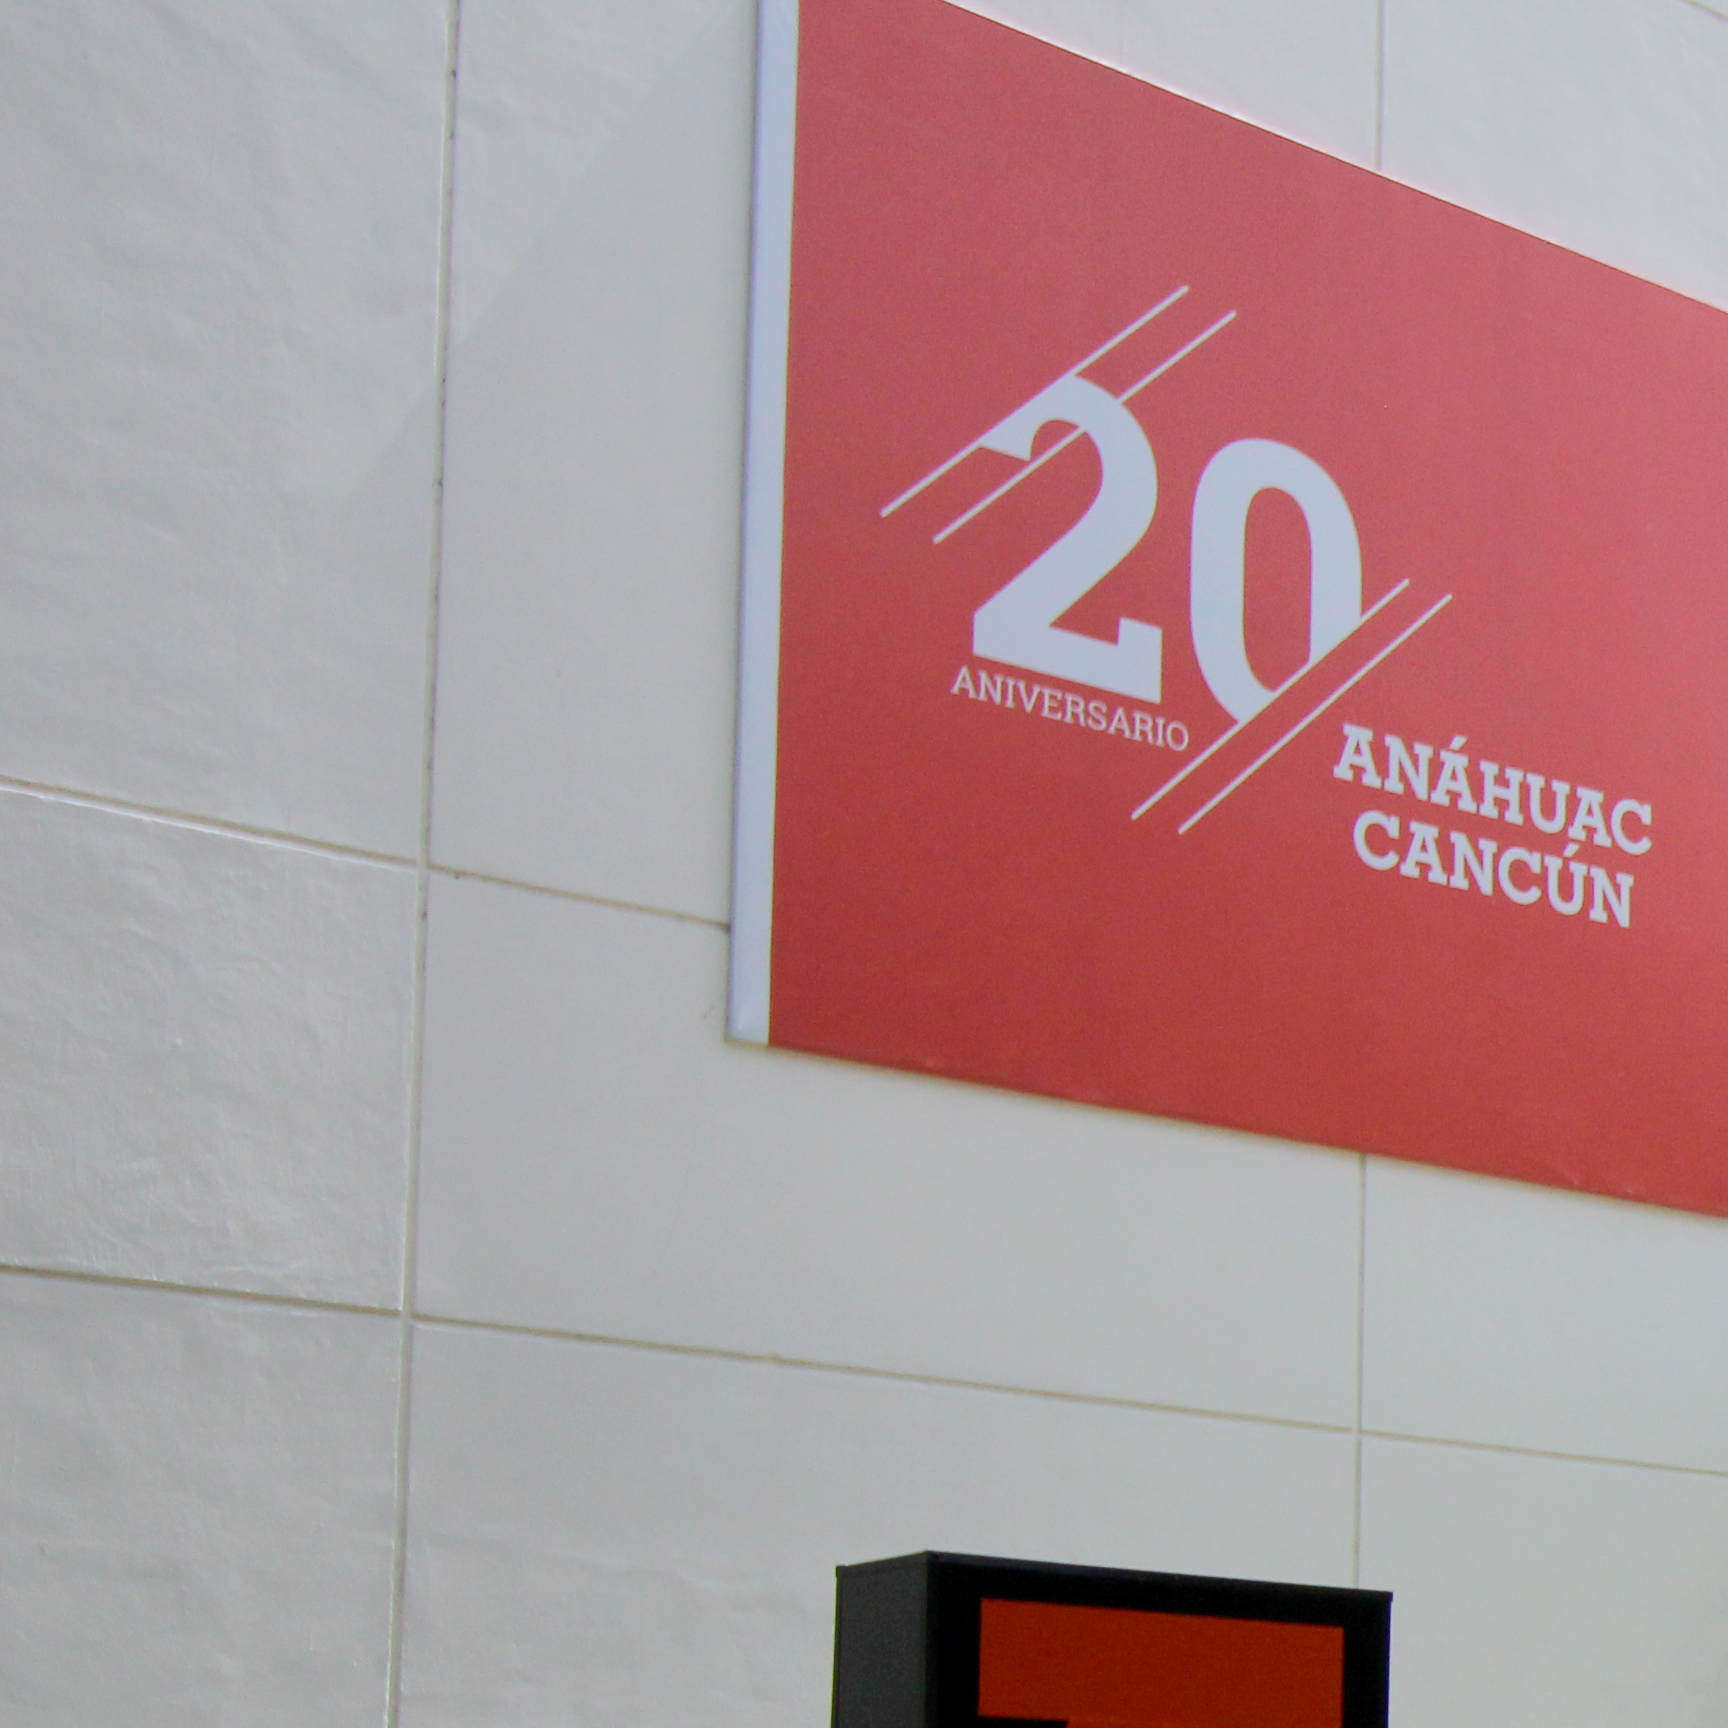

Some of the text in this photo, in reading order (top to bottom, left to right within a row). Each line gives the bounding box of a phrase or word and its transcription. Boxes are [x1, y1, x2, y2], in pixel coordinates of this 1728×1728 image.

[972, 374, 1362, 724] 20
[950, 665, 1190, 751] ANIVERSARIO
[1333, 723, 1652, 855] ANÁHUAC
[1353, 810, 1635, 928] CANCÚN
